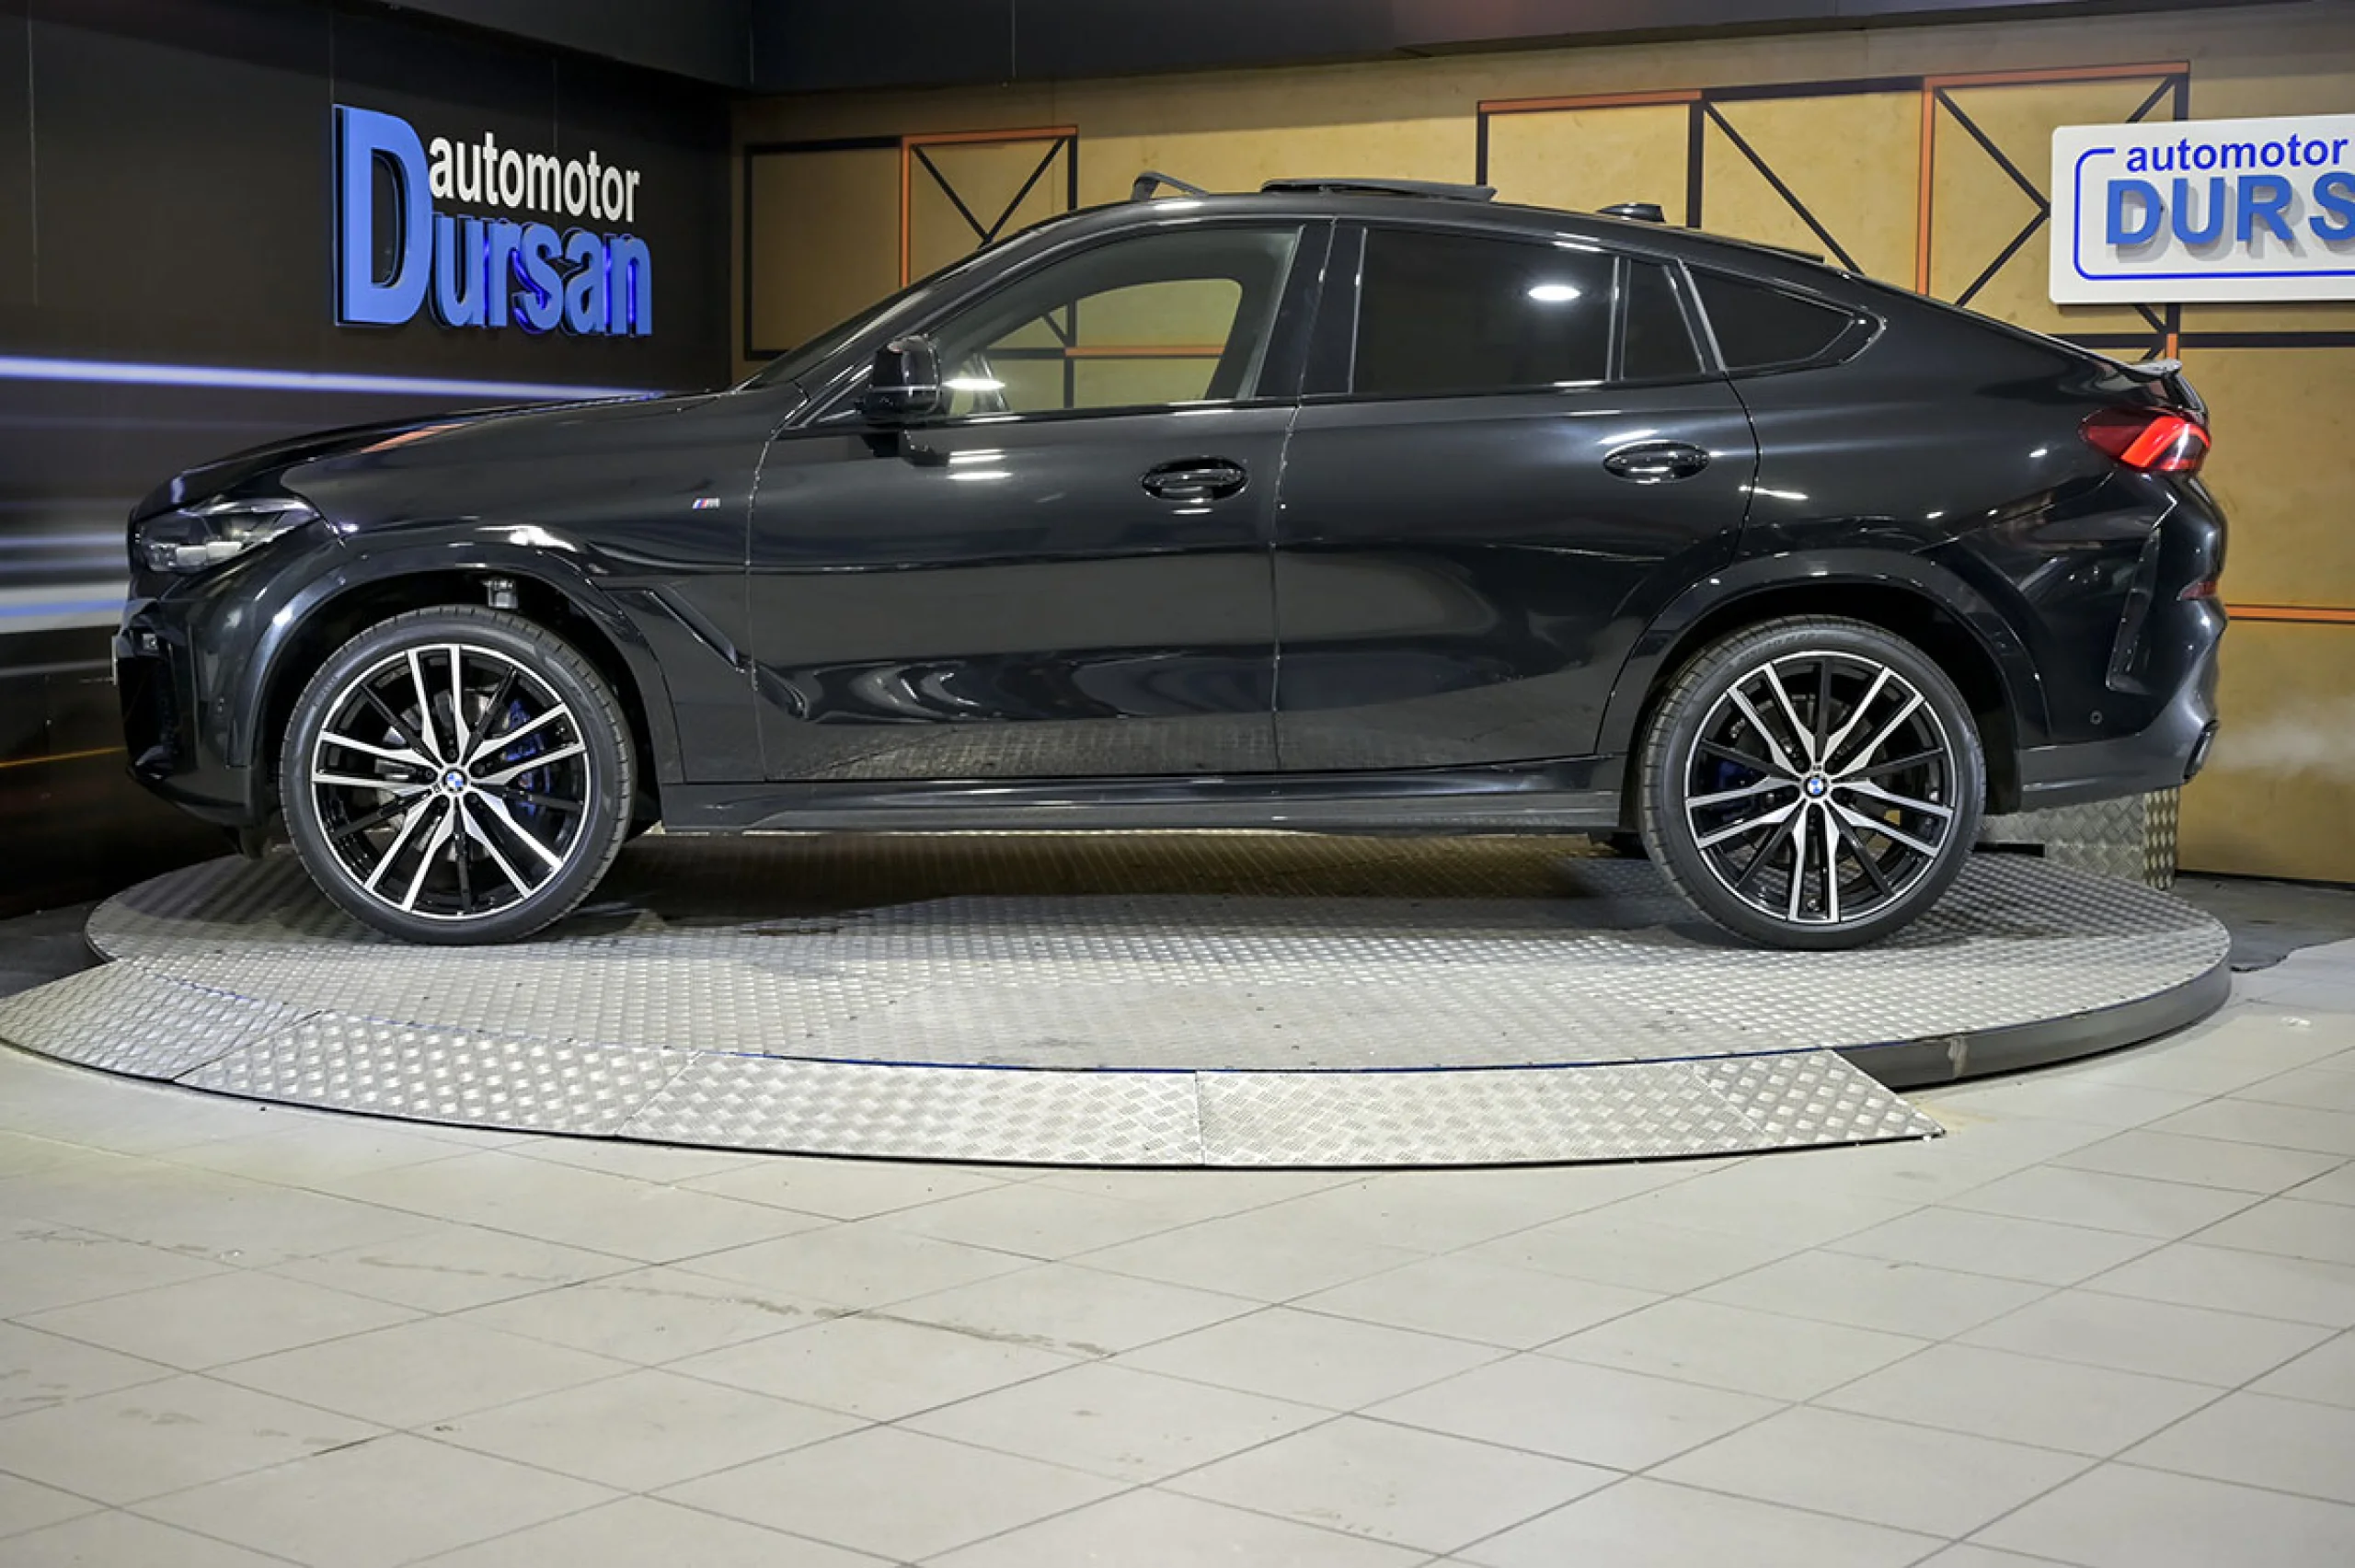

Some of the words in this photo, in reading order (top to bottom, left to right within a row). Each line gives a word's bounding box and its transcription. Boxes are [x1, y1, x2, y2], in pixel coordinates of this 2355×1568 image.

[429, 131, 640, 223] automotor
[2126, 133, 2349, 173] automotor
[332, 103, 652, 337] Dursan
[2105, 171, 2355, 246] DURS
